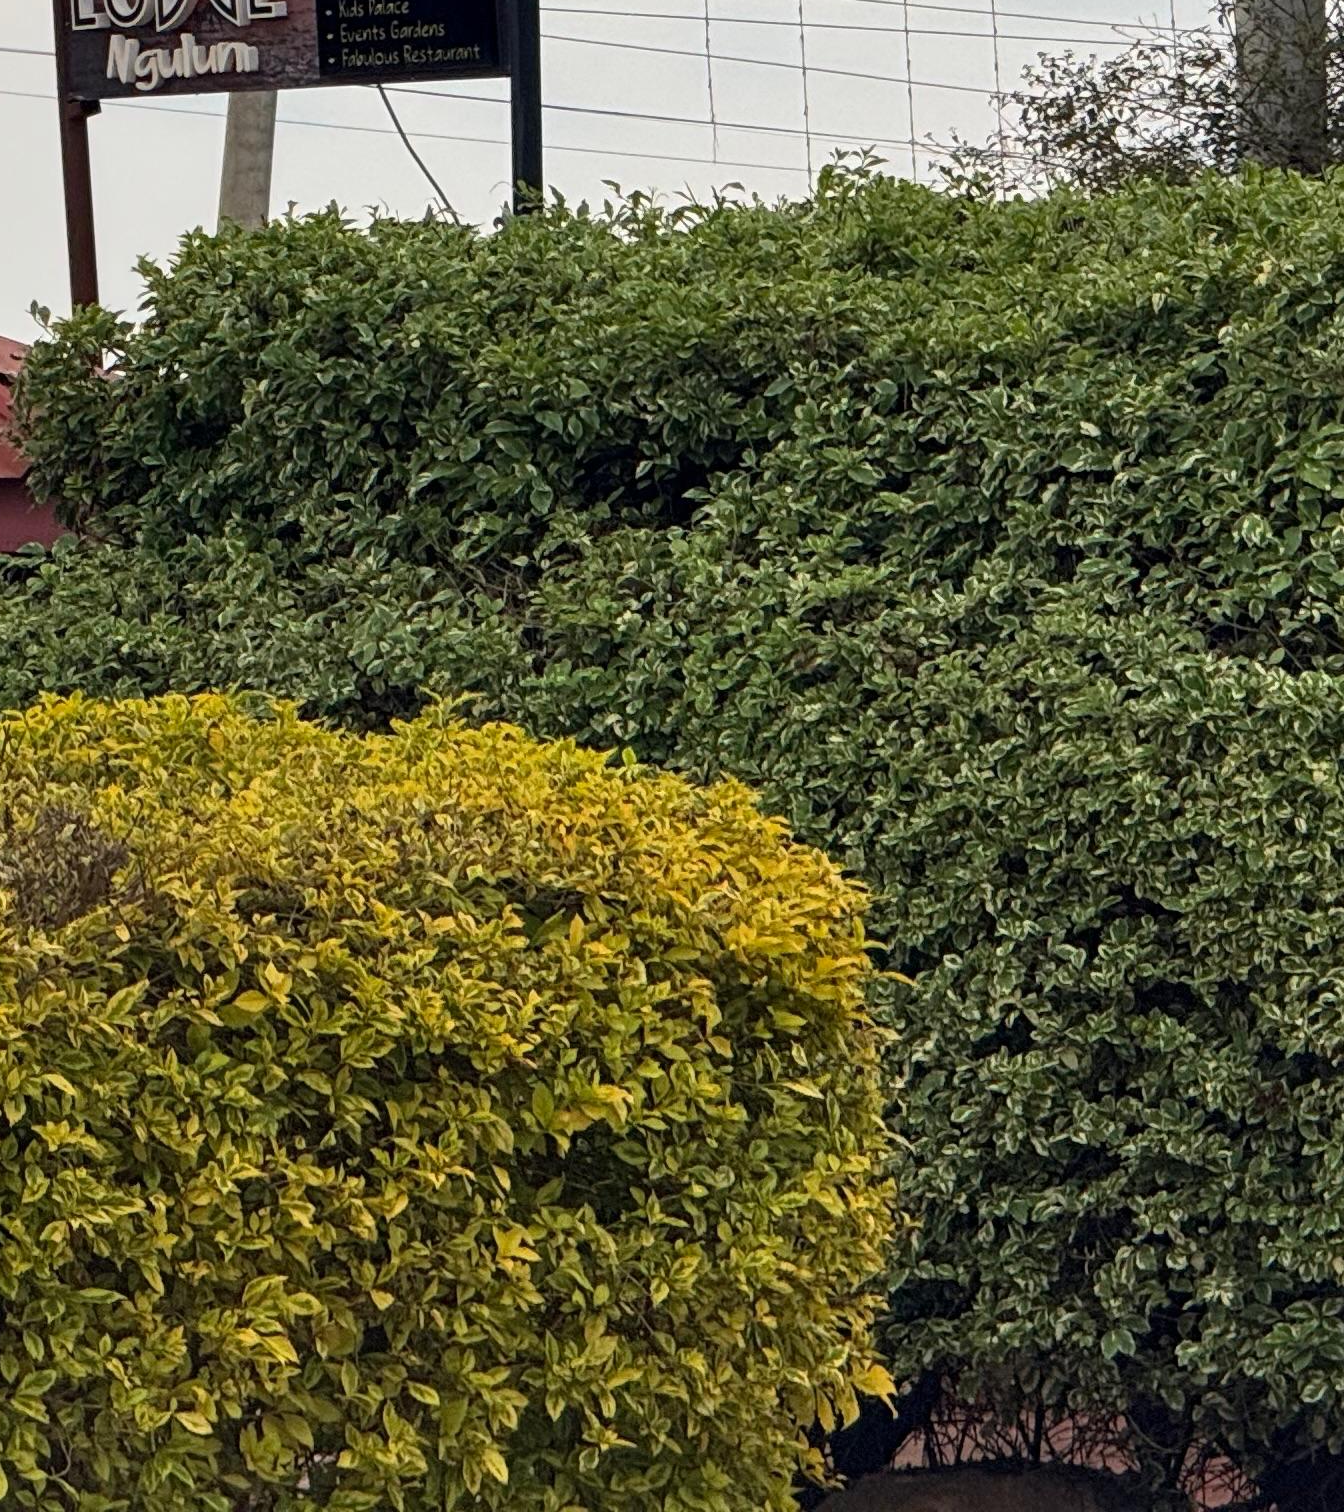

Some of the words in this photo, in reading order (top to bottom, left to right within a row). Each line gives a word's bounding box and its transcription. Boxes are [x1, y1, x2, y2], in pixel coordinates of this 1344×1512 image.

[338, 0, 364, 18] Kids
[340, 23, 386, 43] Events
[390, 19, 446, 39] Gardens
[341, 47, 400, 68] Fabulous
[403, 44, 481, 64] Restaurant
